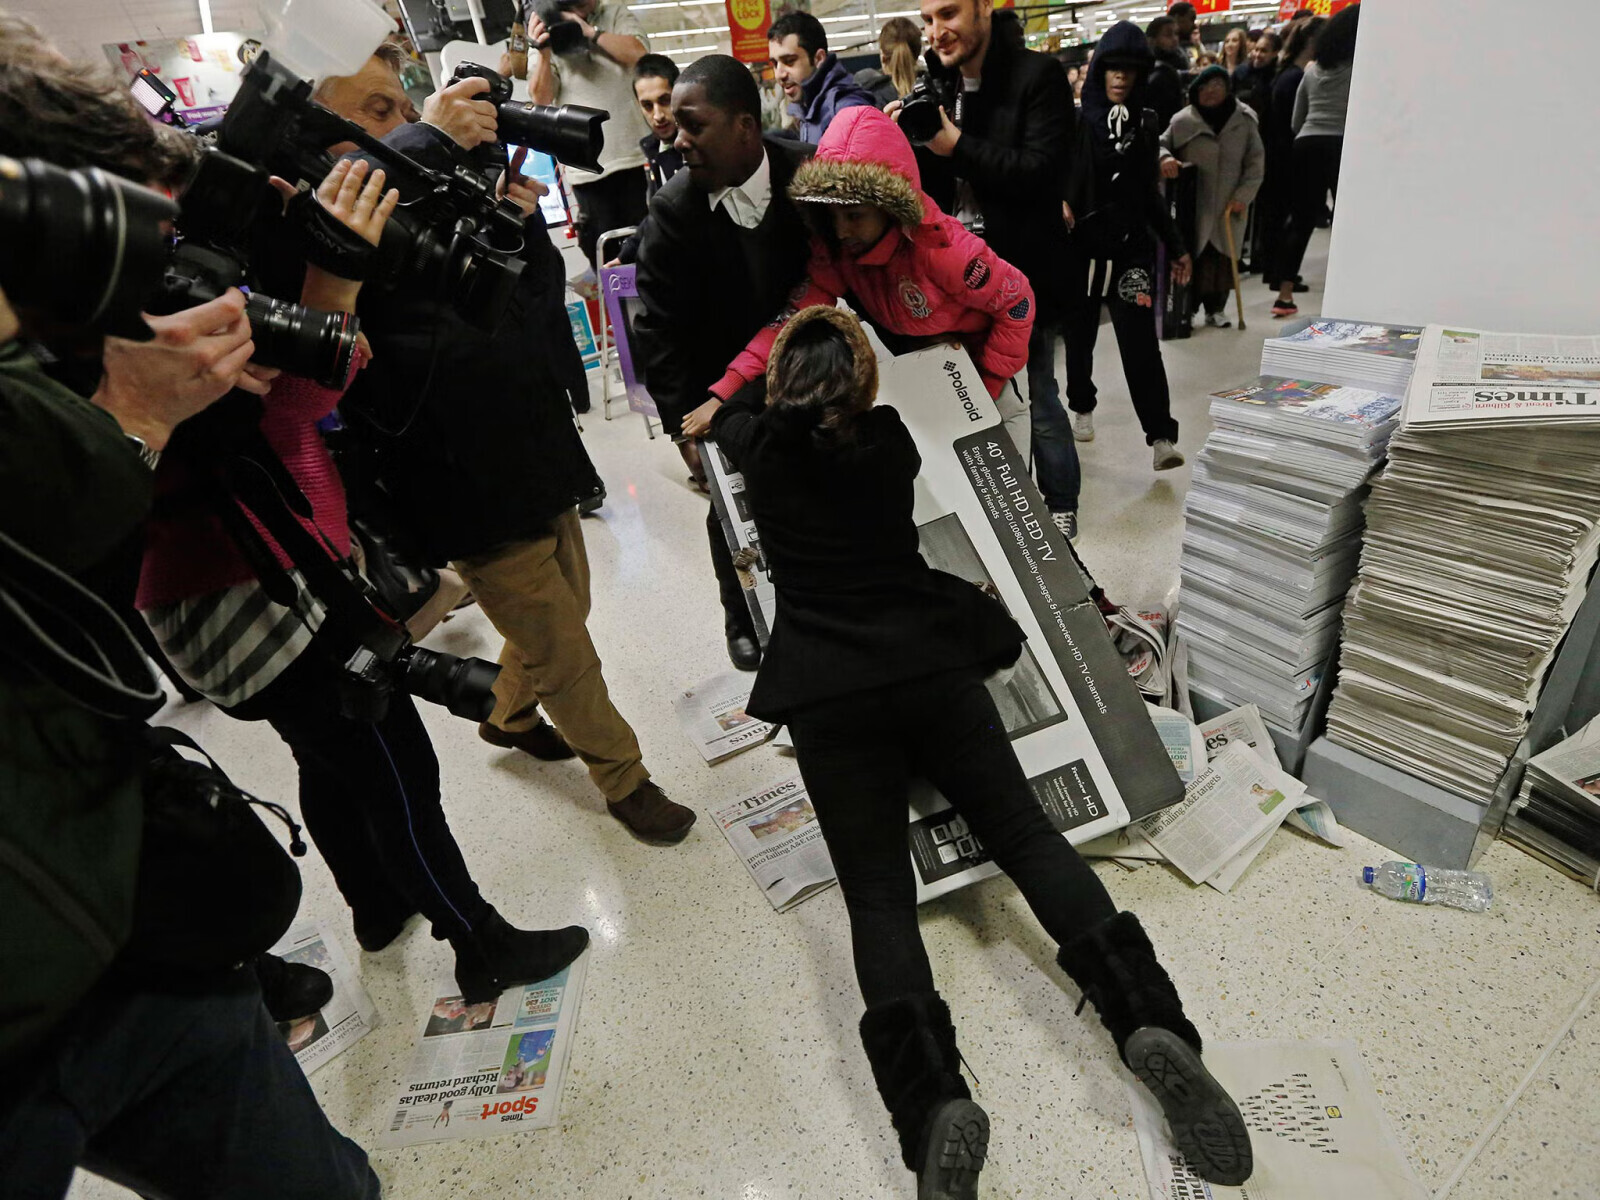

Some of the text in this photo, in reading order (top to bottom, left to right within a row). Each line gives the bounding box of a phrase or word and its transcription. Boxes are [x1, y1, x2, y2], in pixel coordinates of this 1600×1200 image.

[305, 222, 347, 255] SONY
[948, 369, 982, 423] Polaroid
[1475, 391, 1596, 405] Times
[961, 449, 1001, 520] with family & friends
[996, 462, 1018, 489] Full
[1009, 487, 1030, 514] HD
[1021, 512, 1044, 542] LED
[1038, 540, 1056, 562] TV
[971, 445, 1109, 714] Enjoy glorious Full HD (1080p) quality images & Freeview HD TV channels
[738, 780, 797, 810] Times
[1052, 778, 1066, 801] television
[1066, 808, 1074, 818] free
[1057, 776, 1079, 816] Your favourite HD
[1071, 766, 1100, 817] Freeview HD
[1185, 766, 1214, 795] aunched
[1148, 774, 1222, 838] into failing A&E targets
[747, 824, 821, 864] Investigation launche
[751, 857, 766, 870] into
[766, 846, 790, 862] failing
[789, 838, 807, 850] A&E
[399, 1085, 496, 1105] Jolly good deal as
[409, 1073, 499, 1092] Richard returns
[481, 1096, 539, 1119] Sport
[501, 1113, 523, 1122] Times
